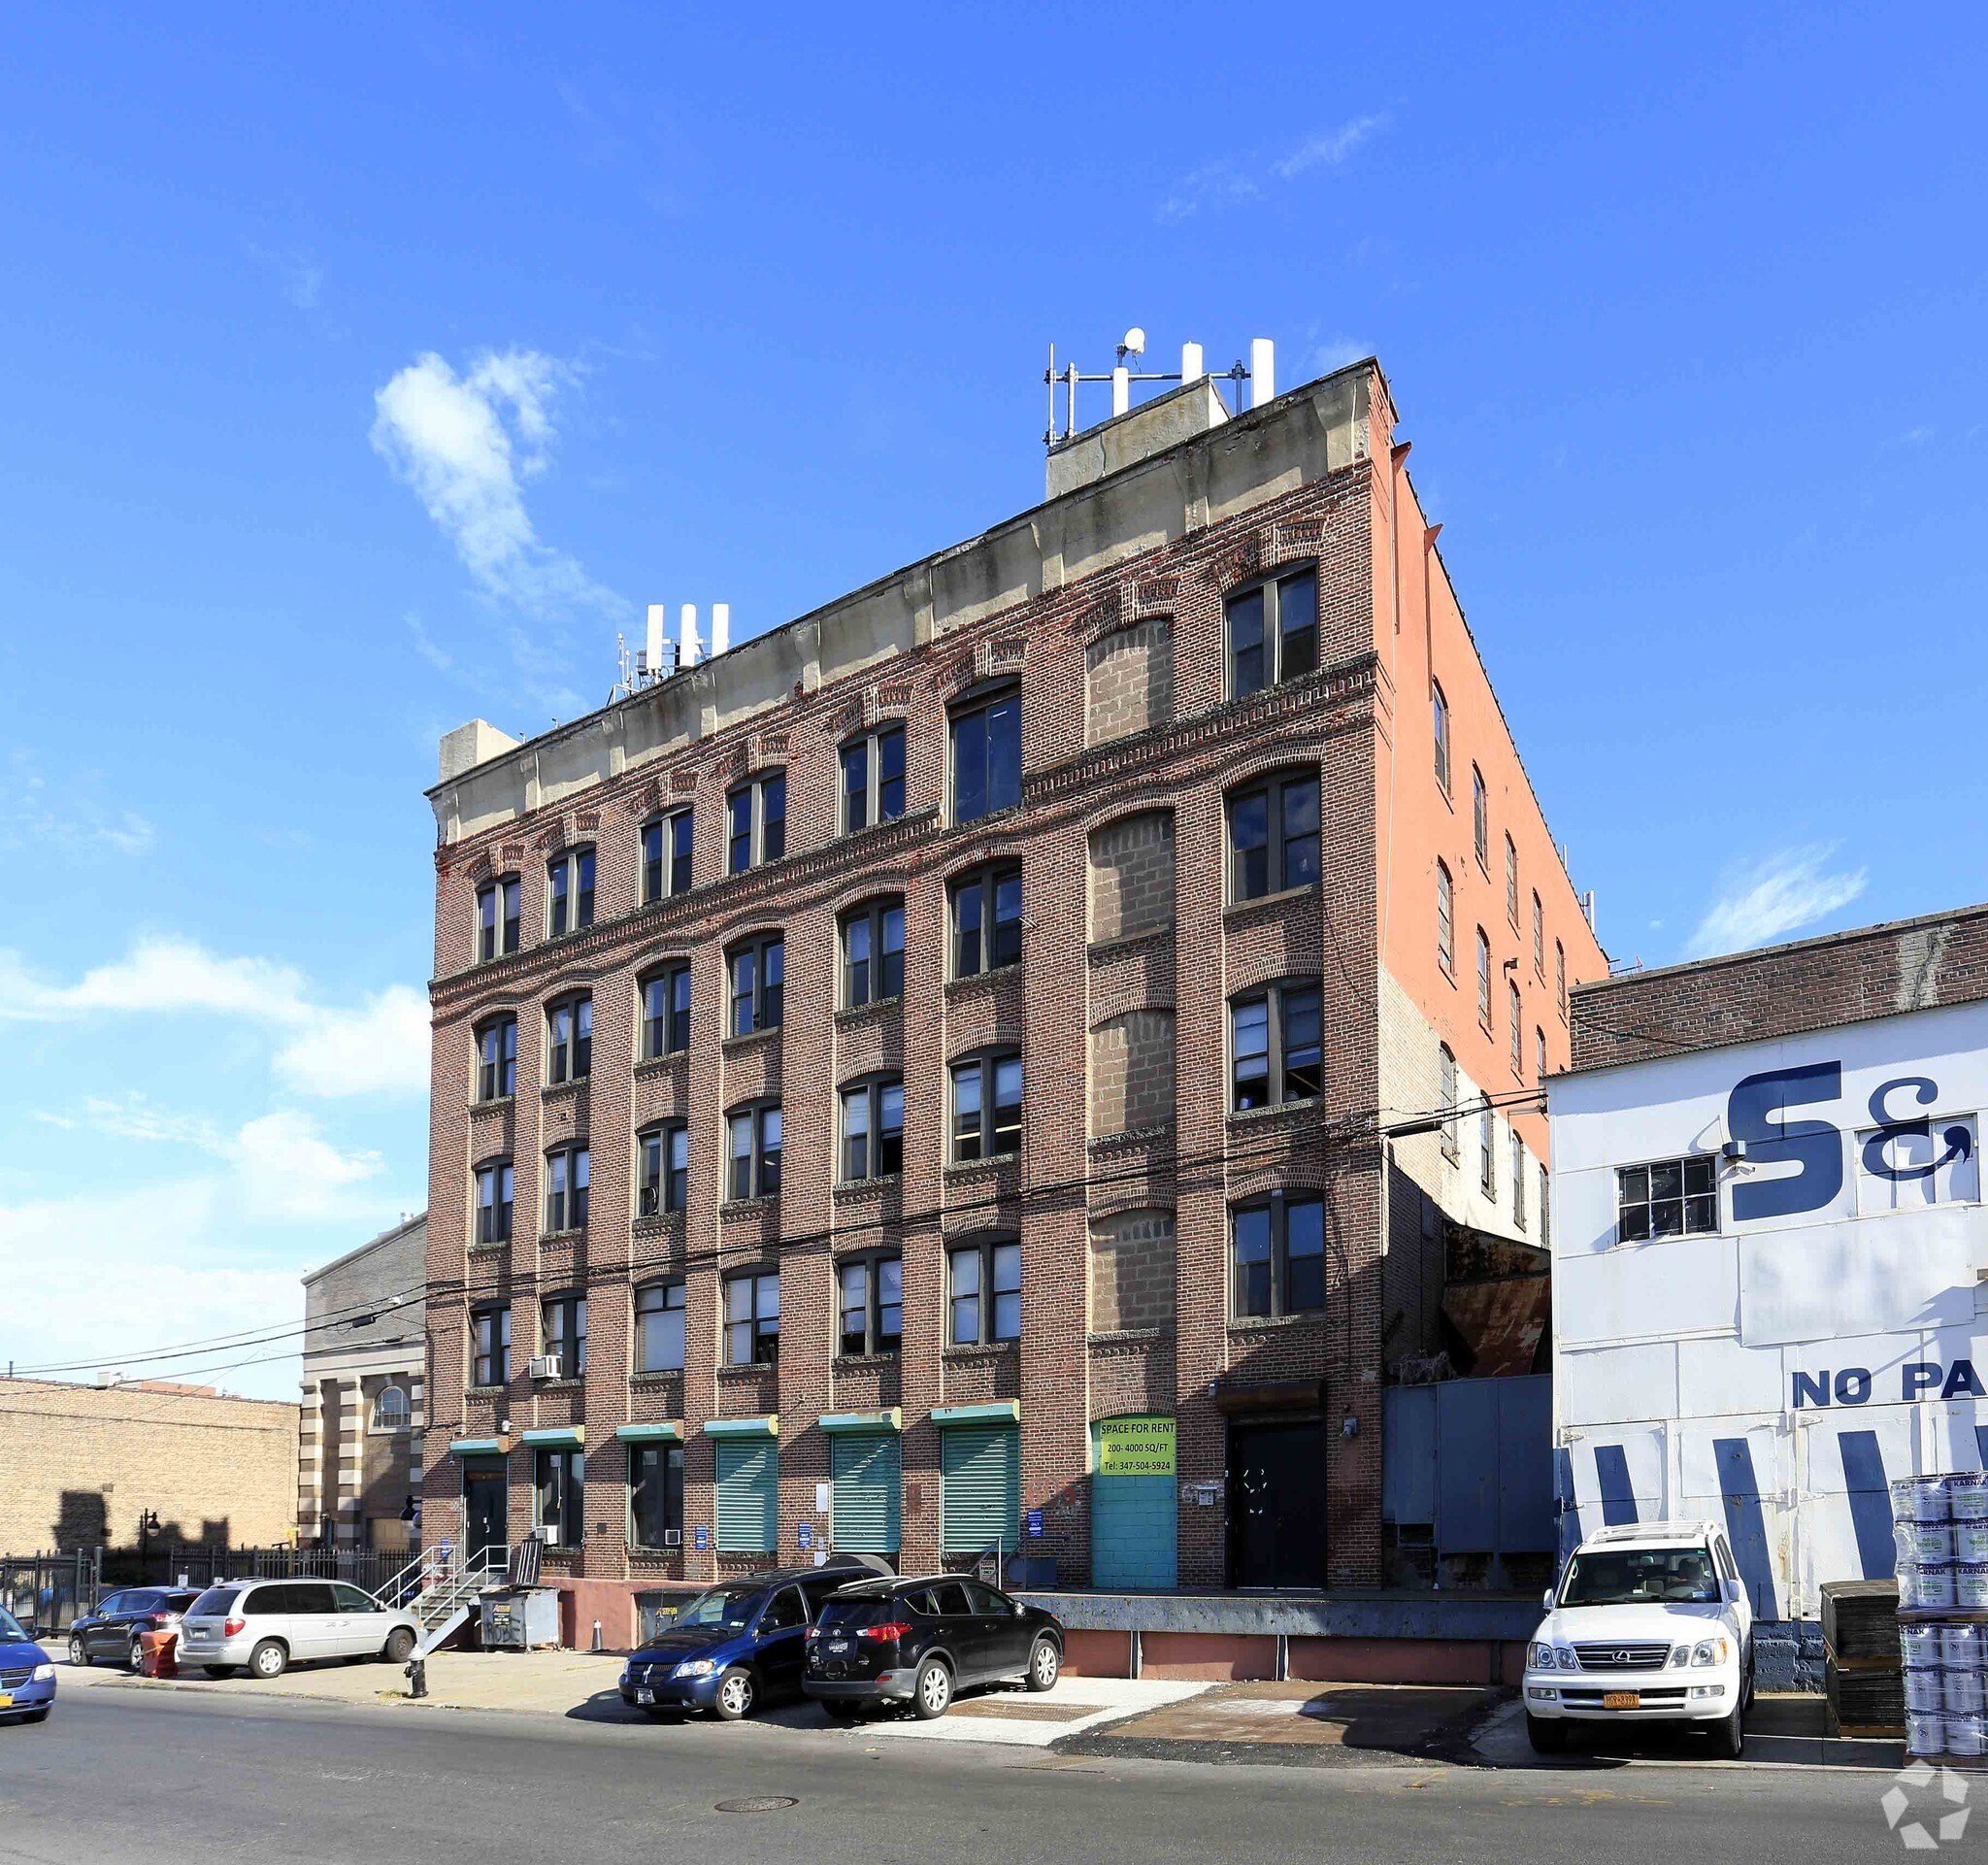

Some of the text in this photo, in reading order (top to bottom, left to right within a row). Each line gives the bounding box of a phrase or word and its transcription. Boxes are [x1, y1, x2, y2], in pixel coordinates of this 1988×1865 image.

[1792, 1359, 1987, 1409] NO PA
[1101, 1422, 1176, 1435] SPACE FOR RENT
[1124, 1443, 1143, 1452] 4000
[1144, 1443, 1169, 1453] SQ/FT
[1105, 1461, 1171, 1470] Tel: 347-504-5924
